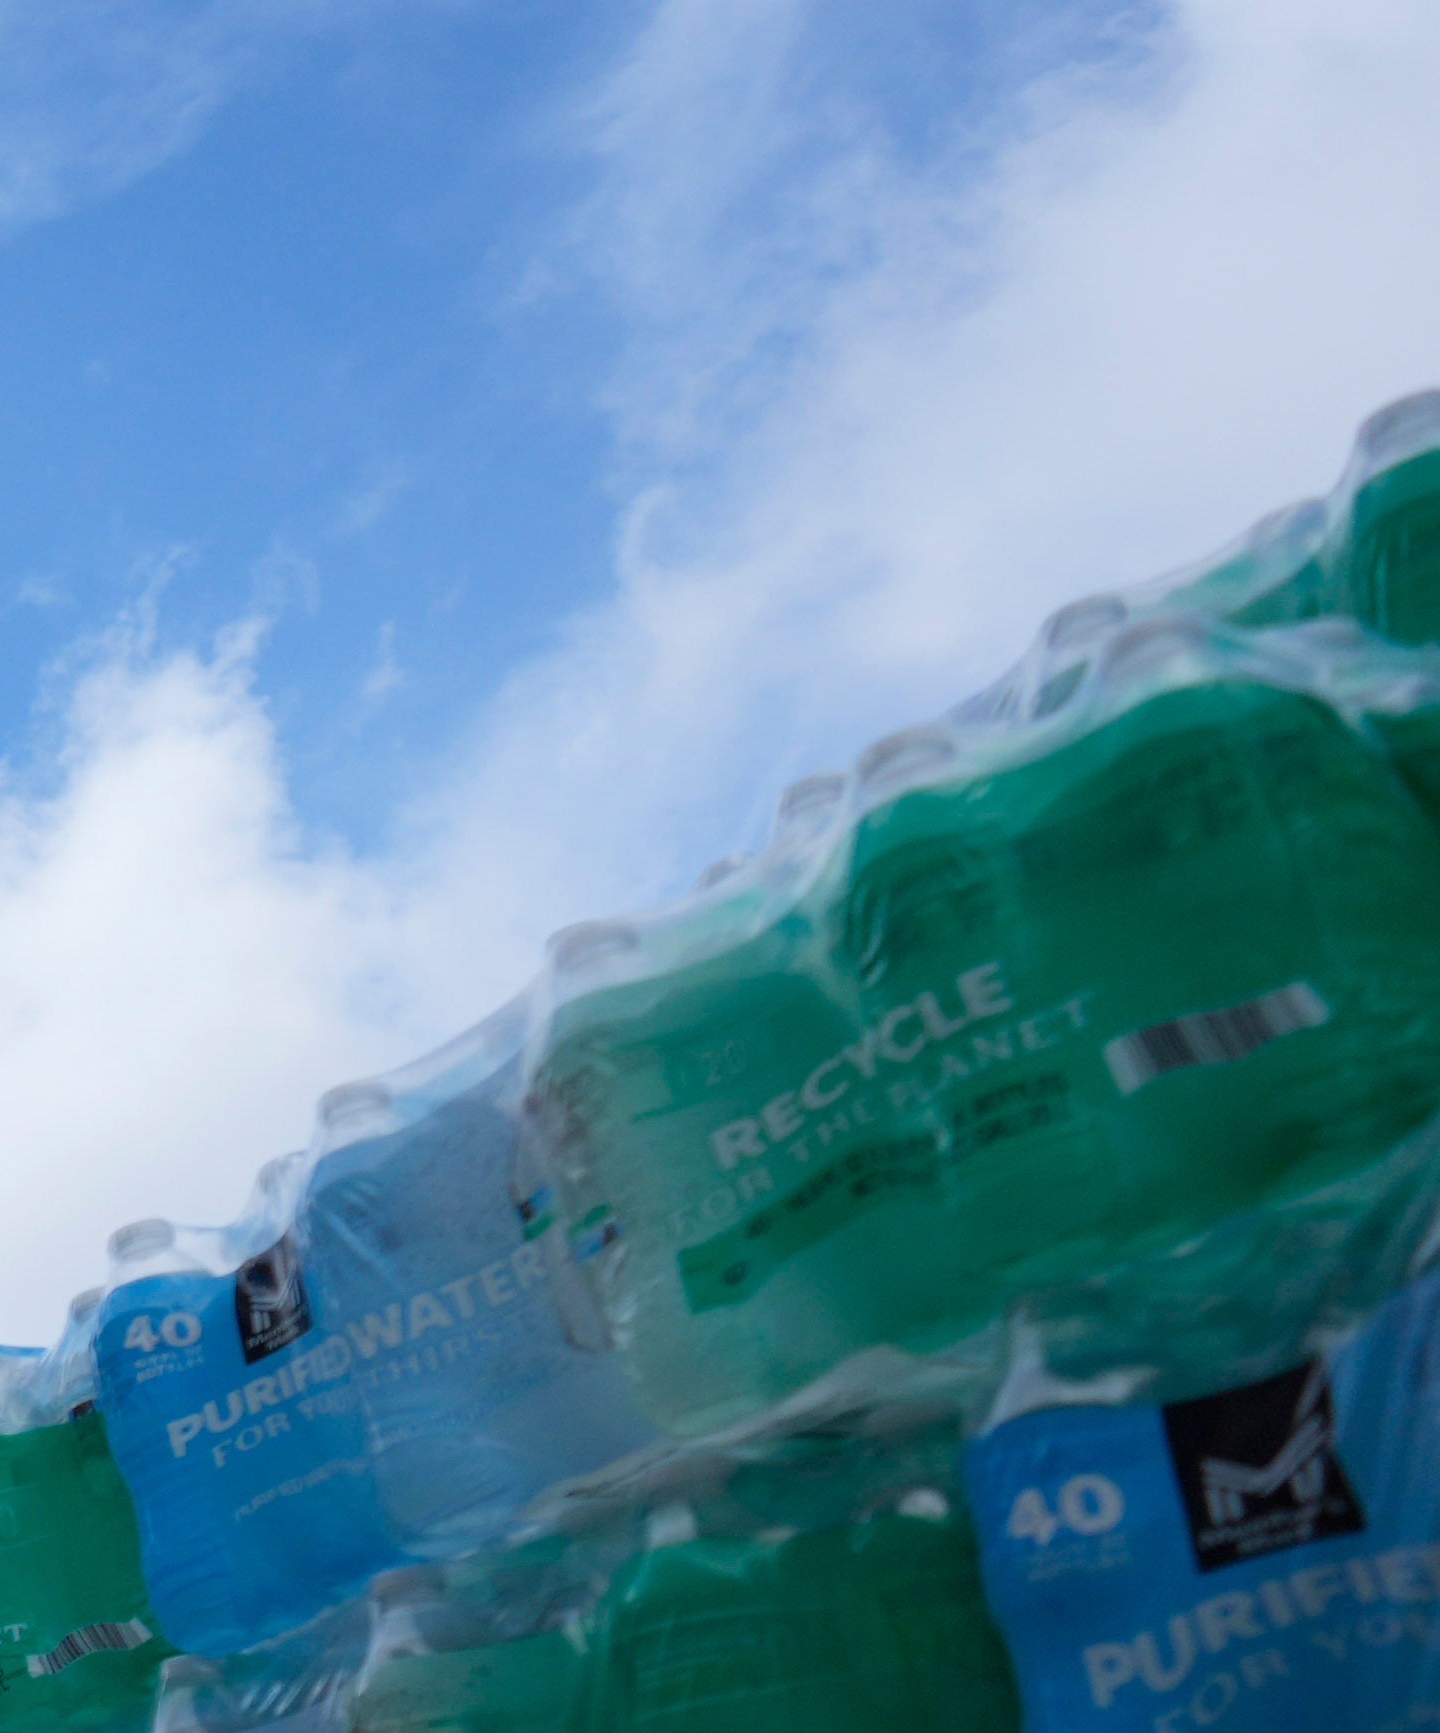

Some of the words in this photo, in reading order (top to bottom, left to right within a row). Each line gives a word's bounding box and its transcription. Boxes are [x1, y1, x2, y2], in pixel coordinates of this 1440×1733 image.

[708, 961, 1014, 1170] RECYCLE
[124, 1310, 203, 1352] 40
[347, 1243, 548, 1359] WATER
[212, 1413, 290, 1468] FOR
[1007, 1473, 1124, 1546] 40
